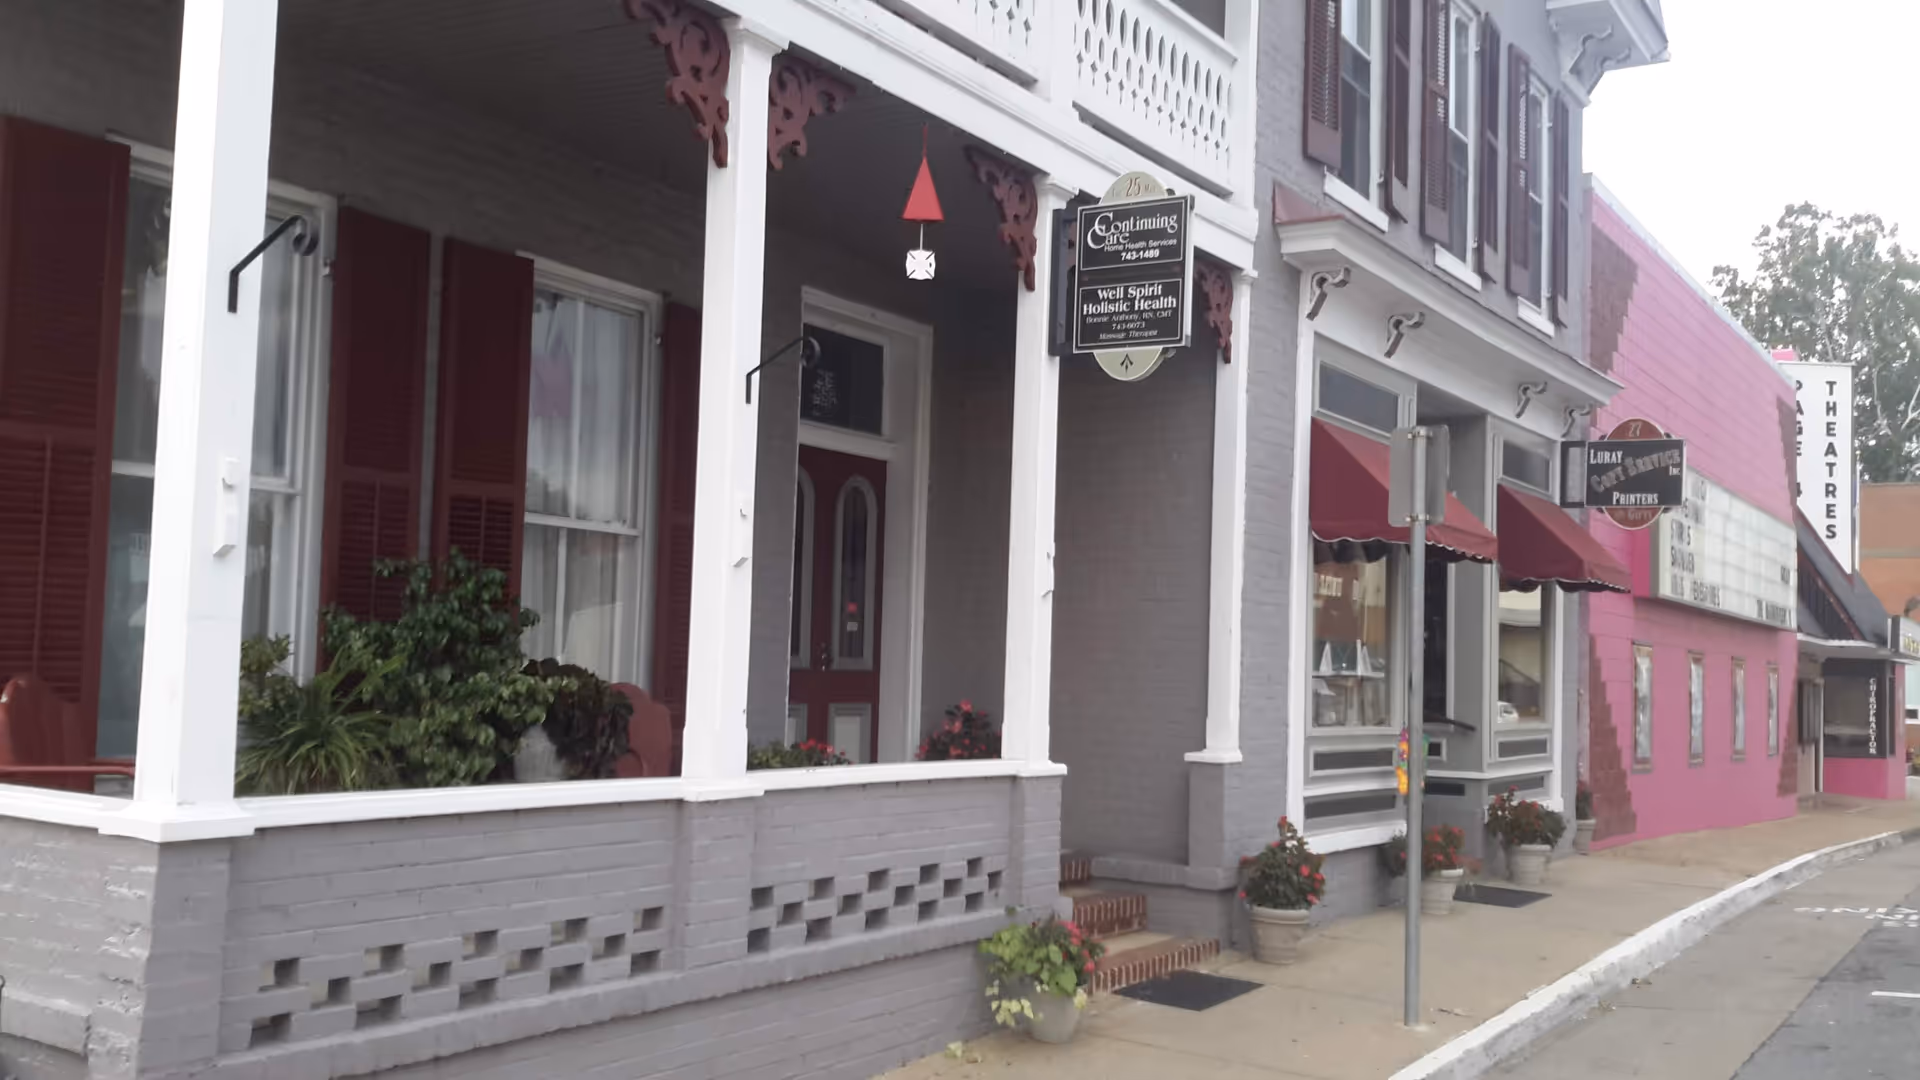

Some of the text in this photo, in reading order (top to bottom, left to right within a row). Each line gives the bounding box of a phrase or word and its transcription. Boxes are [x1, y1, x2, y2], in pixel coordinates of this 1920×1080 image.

[1126, 176, 1141, 197] 25
[1094, 212, 1178, 237] Continuing
[1087, 225, 1130, 249] Care
[1104, 239, 1177, 252] Home Health Services
[1097, 282, 1162, 300] Well Spirit
[1083, 296, 1177, 315] Holistic Health
[1628, 422, 1642, 437] 27
[1589, 449, 1623, 464] LURAY
[1824, 381, 1838, 539] THEATRES
[1613, 492, 1658, 505] PRINTERS
